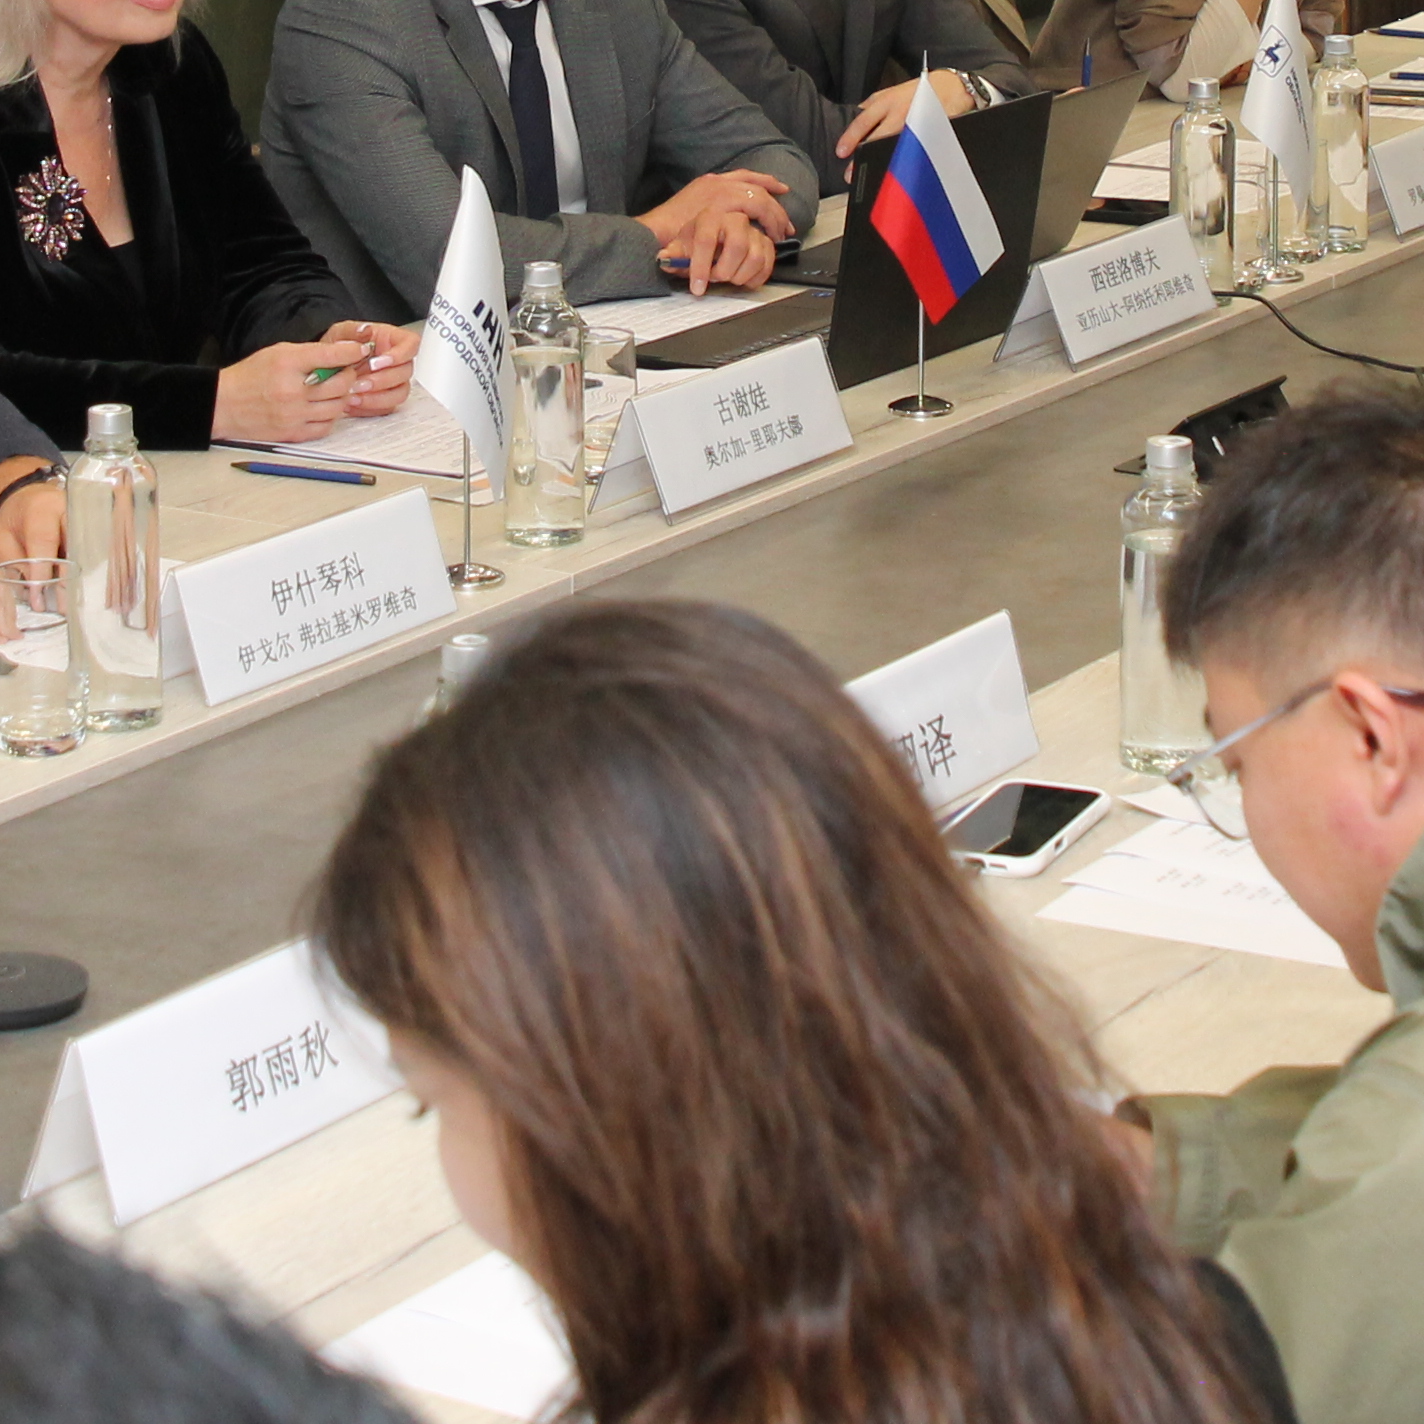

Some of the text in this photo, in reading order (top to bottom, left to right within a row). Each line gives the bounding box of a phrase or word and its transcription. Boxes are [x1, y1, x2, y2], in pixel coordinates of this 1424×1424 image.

[1088, 247, 1161, 293] 西涅洛博夫
[433, 293, 490, 364] ОРПОРАЦИЯ
[713, 381, 771, 427] 古谢娃
[271, 551, 366, 616] 伊什琴科
[238, 585, 418, 674] 伊戈尔 弗拉基米罗维奇
[224, 1020, 340, 1112] 郭雨秋
